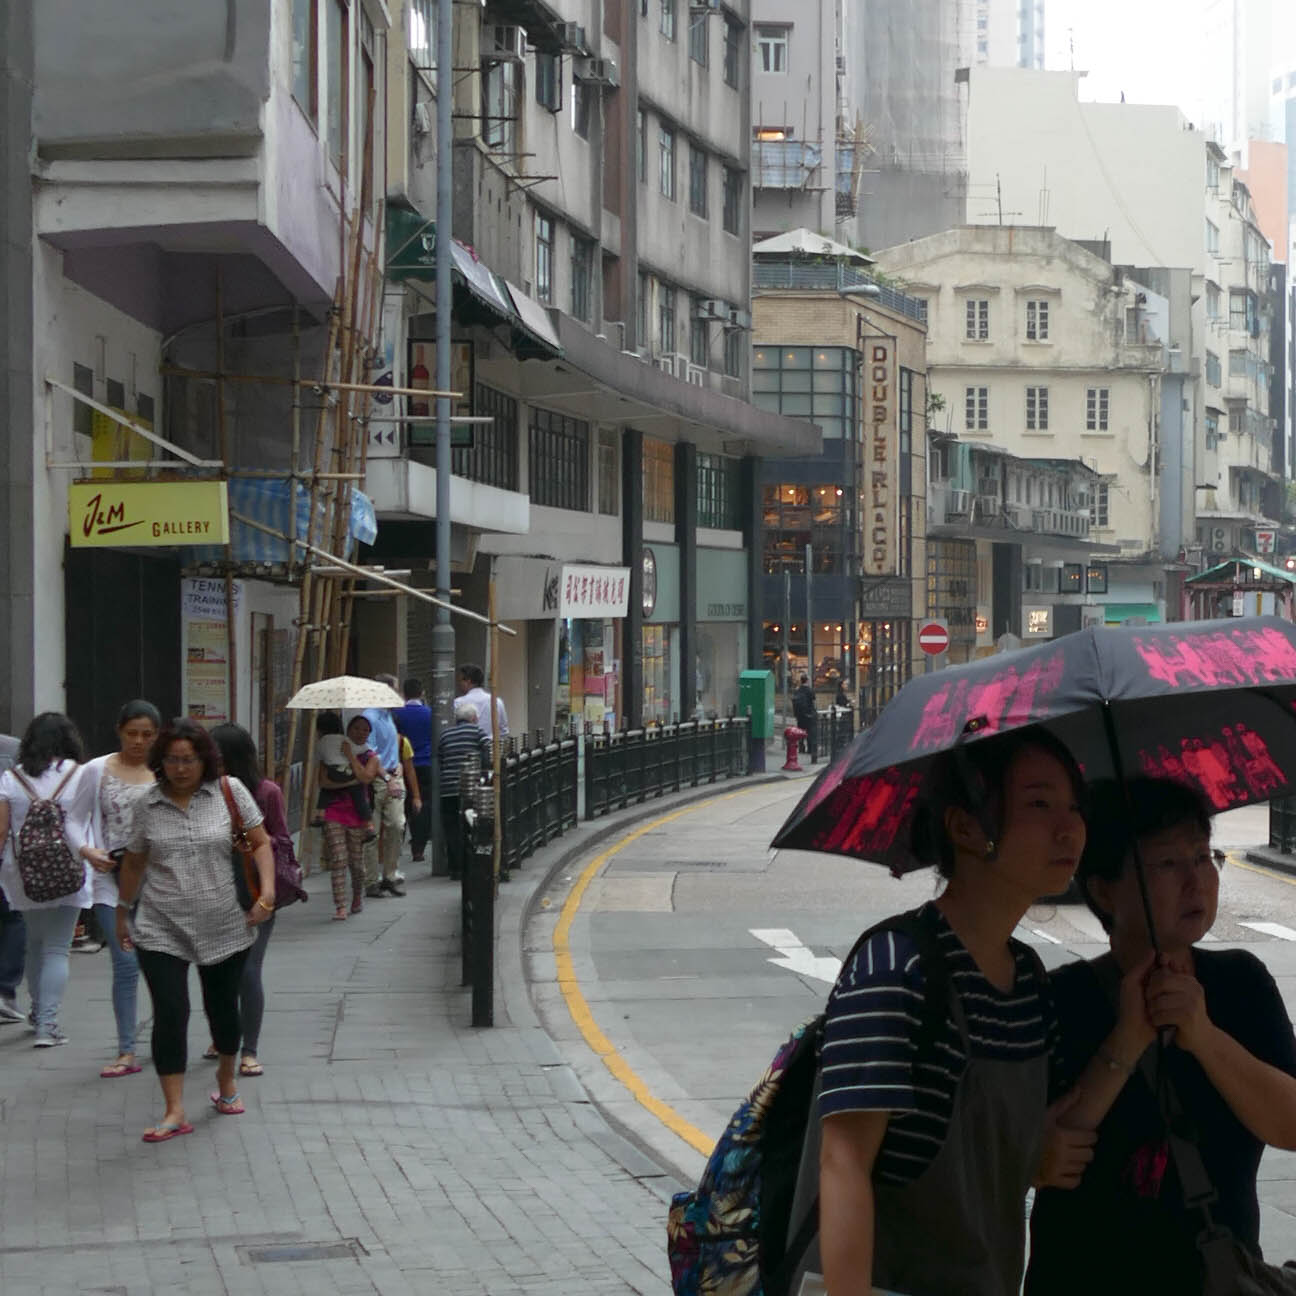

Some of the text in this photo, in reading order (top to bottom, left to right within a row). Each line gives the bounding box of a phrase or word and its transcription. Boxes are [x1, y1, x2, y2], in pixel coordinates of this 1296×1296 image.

[872, 345, 888, 462] DOUBLE
[152, 520, 210, 537] GALLERY
[190, 579, 239, 595] TENNS
